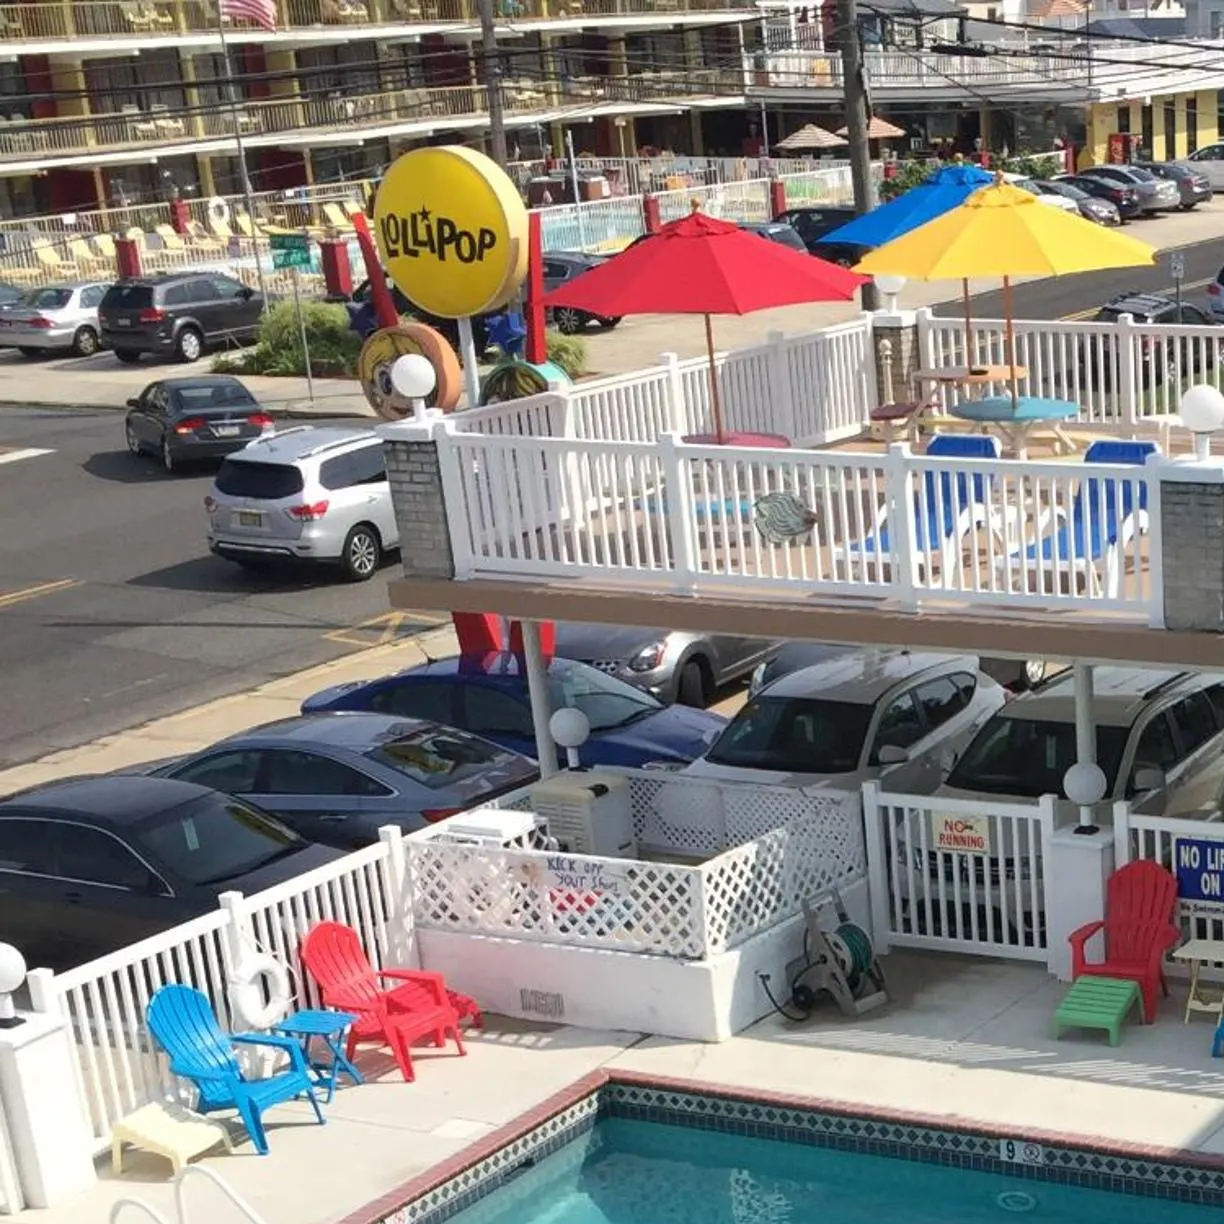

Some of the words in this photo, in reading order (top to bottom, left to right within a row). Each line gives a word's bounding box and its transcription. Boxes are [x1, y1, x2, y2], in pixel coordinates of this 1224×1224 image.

[380, 205, 497, 263] LOLLIPOP
[944, 819, 965, 833] NO
[938, 833, 985, 849] RUNNING
[1179, 845, 1200, 869] NO
[1200, 872, 1221, 896] ON
[1006, 1140, 1016, 1160] 9
